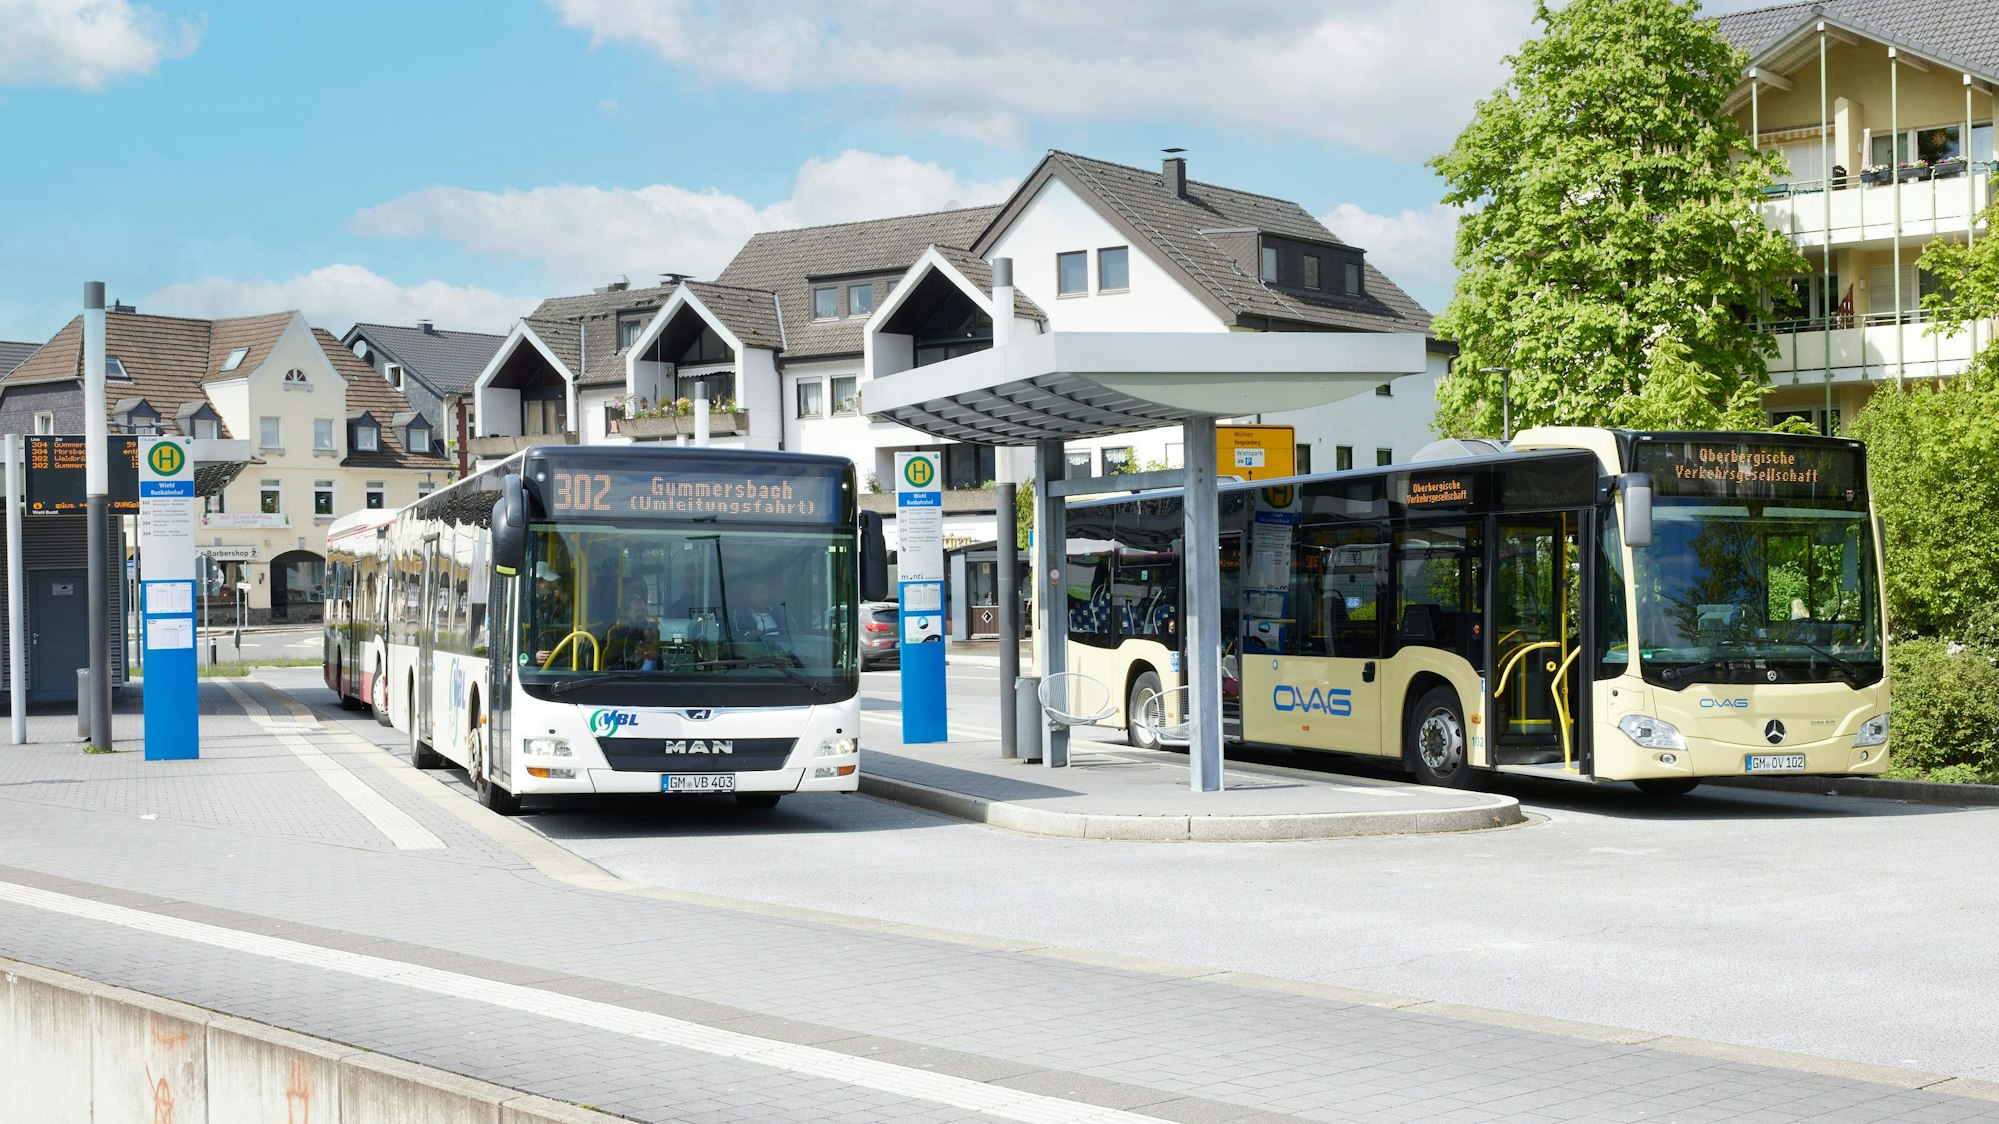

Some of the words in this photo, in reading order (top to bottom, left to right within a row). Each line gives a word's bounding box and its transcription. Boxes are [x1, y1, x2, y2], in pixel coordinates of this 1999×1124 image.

[1700, 448, 1794, 466] Oberbergische
[1676, 464, 1818, 483] Verkehrsgesellschaft
[554, 474, 611, 510] 302
[652, 476, 792, 500] Gummersbach
[1413, 480, 1460, 492] Oberbergische
[1406, 490, 1467, 504] Verkehrsgesellschaft
[630, 496, 814, 514] (Umleitungsfahrt)
[1274, 685, 1351, 716] OVAG
[1700, 698, 1748, 708] OVAG
[603, 710, 638, 726] VBL
[665, 741, 733, 754] MAN
[1472, 736, 1484, 747] 102
[1752, 758, 1765, 769] GM
[1771, 757, 1784, 768] OV
[1786, 757, 1803, 768] 102
[670, 777, 685, 788] GM
[693, 777, 708, 788] VB
[711, 776, 733, 788] 403
